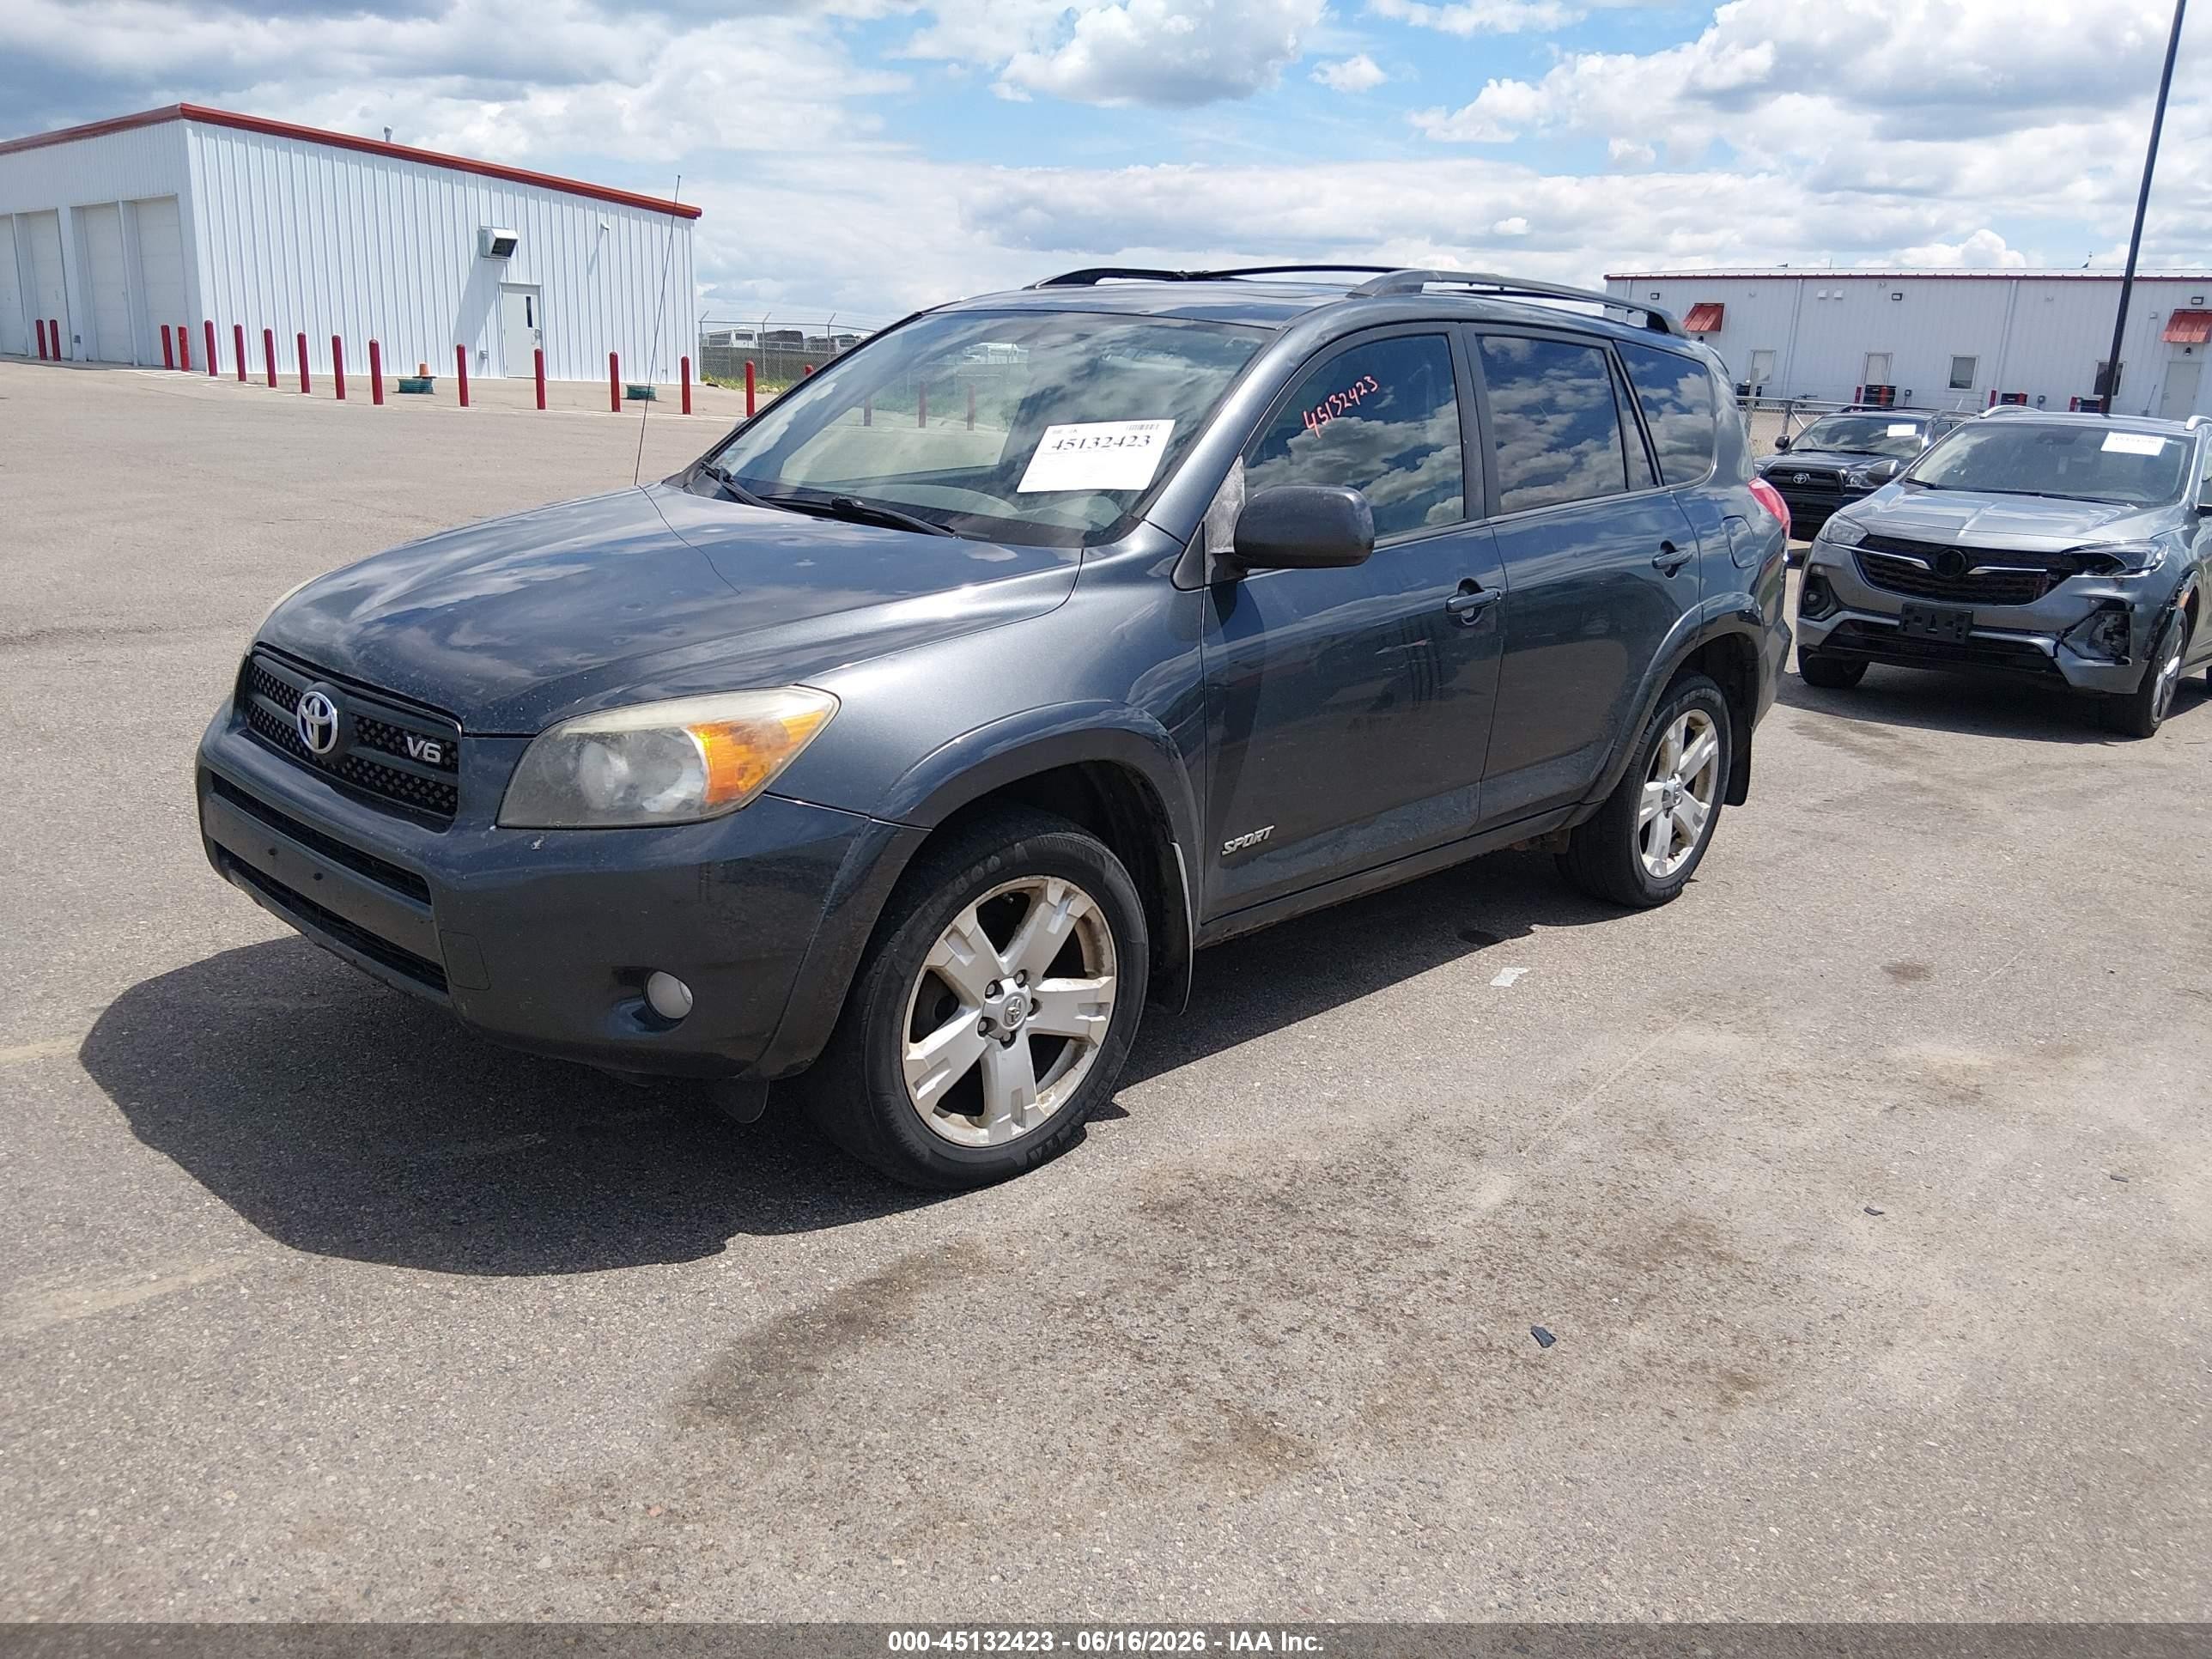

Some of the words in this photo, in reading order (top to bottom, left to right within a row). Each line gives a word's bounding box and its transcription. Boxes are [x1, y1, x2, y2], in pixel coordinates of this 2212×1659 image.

[1303, 375, 1378, 439] 45132423
[1051, 434, 1151, 451] 45132423
[407, 736, 441, 763] V6
[1221, 824, 1276, 856] SPORT
